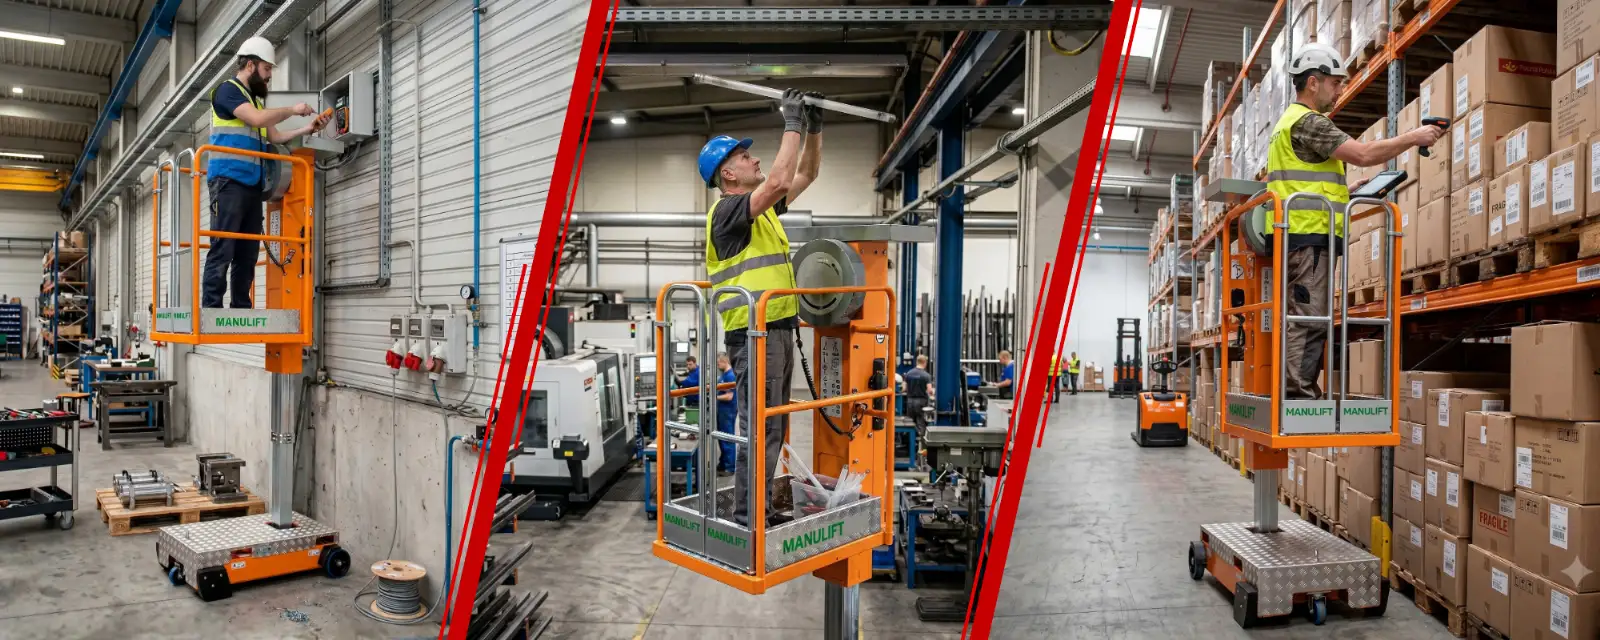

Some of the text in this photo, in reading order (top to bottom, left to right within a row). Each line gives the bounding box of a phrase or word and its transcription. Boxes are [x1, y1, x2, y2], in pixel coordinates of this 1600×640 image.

[1491, 200, 1506, 214] FRAG
[215, 317, 267, 328] MANULIFT
[1285, 407, 1334, 417] MANULIFT
[1343, 406, 1389, 416] MANULIFT
[664, 512, 701, 533] MANULIFT
[1479, 511, 1509, 533] FRAGILE
[707, 527, 748, 550] MANULIFT
[782, 521, 845, 555] MANULIFT
